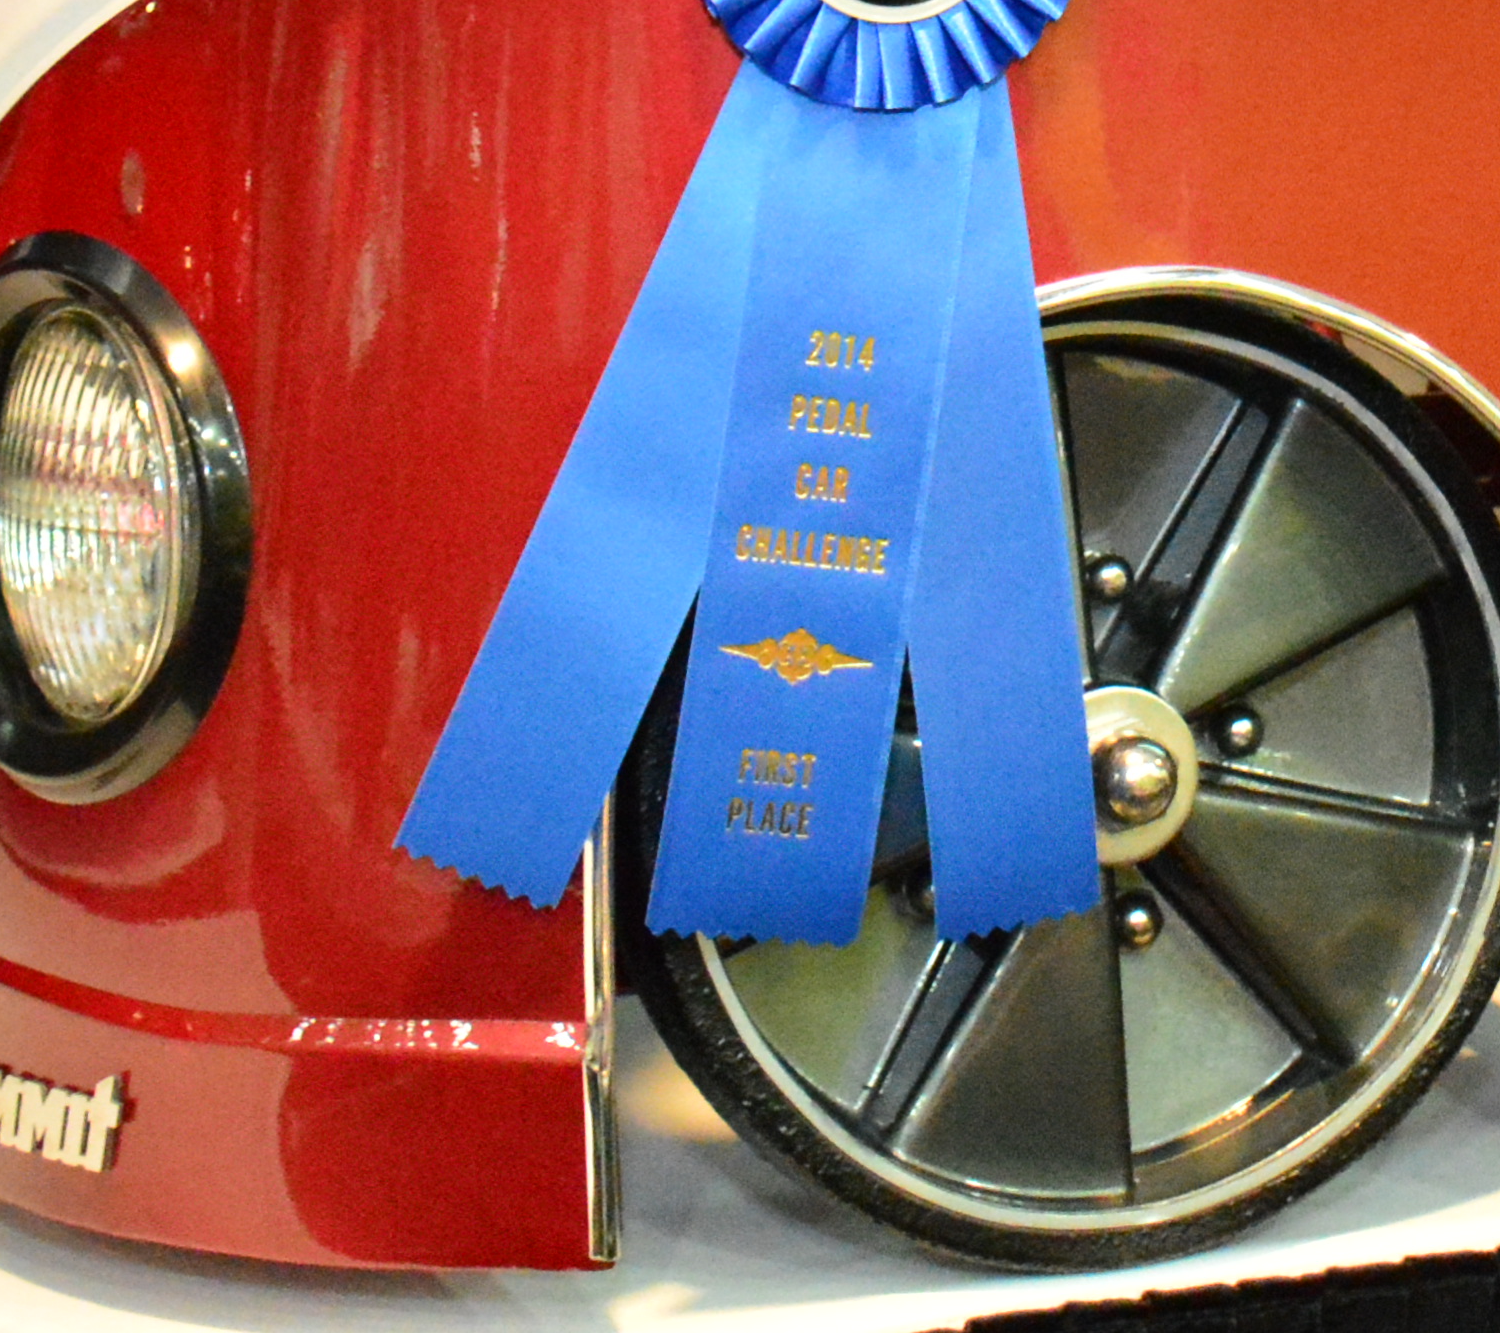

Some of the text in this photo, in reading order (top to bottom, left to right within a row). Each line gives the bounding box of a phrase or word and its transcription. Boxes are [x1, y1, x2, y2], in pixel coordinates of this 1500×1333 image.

[805, 330, 876, 371] 2014
[788, 394, 873, 439] PEDAL
[794, 462, 849, 503] CAR
[735, 523, 889, 575] CHALLENGE
[736, 748, 817, 789] FIRST
[726, 798, 814, 838] PLACE
